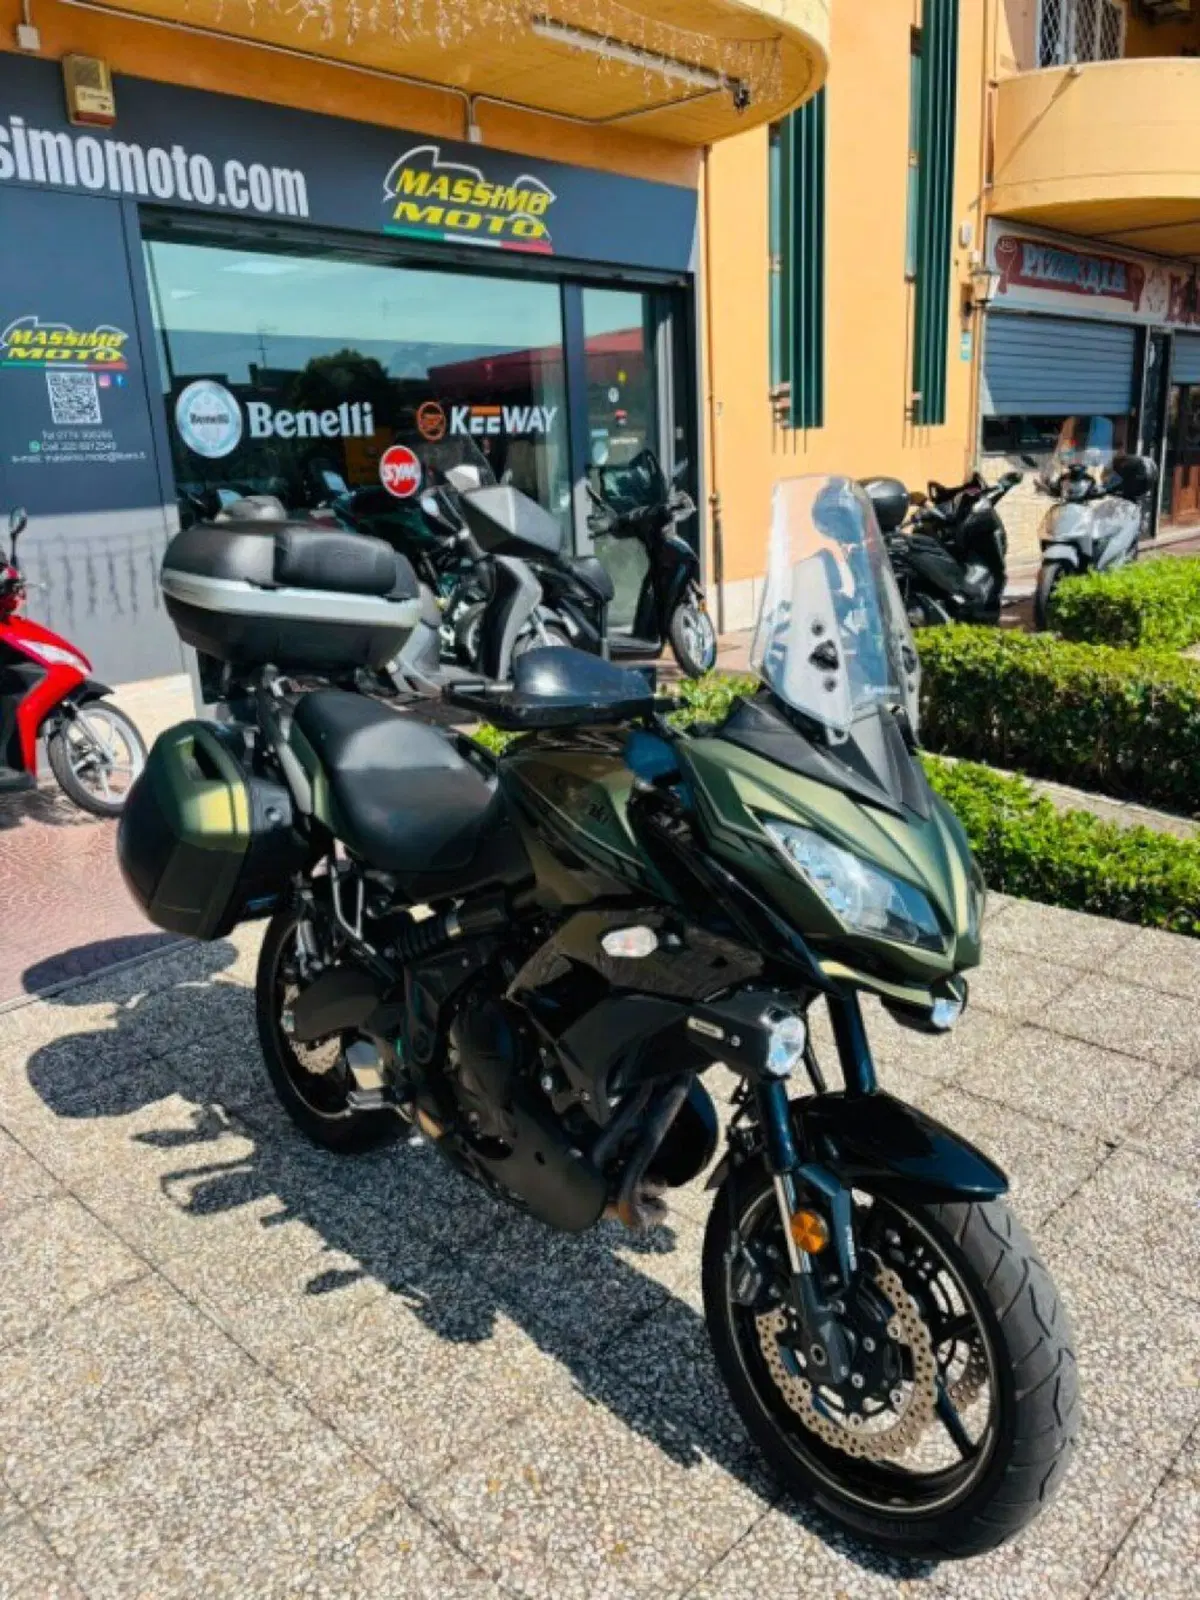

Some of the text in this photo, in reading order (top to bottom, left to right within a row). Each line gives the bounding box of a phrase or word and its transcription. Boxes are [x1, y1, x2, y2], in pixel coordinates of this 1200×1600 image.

[395, 168, 551, 215] MASSIMO
[393, 202, 546, 239] MOTO
[9, 329, 124, 347] MASSIMO
[8, 347, 121, 361] MOTO
[246, 401, 375, 438] Benelli
[452, 405, 558, 434] KEEWAY
[382, 463, 419, 487] SYM
